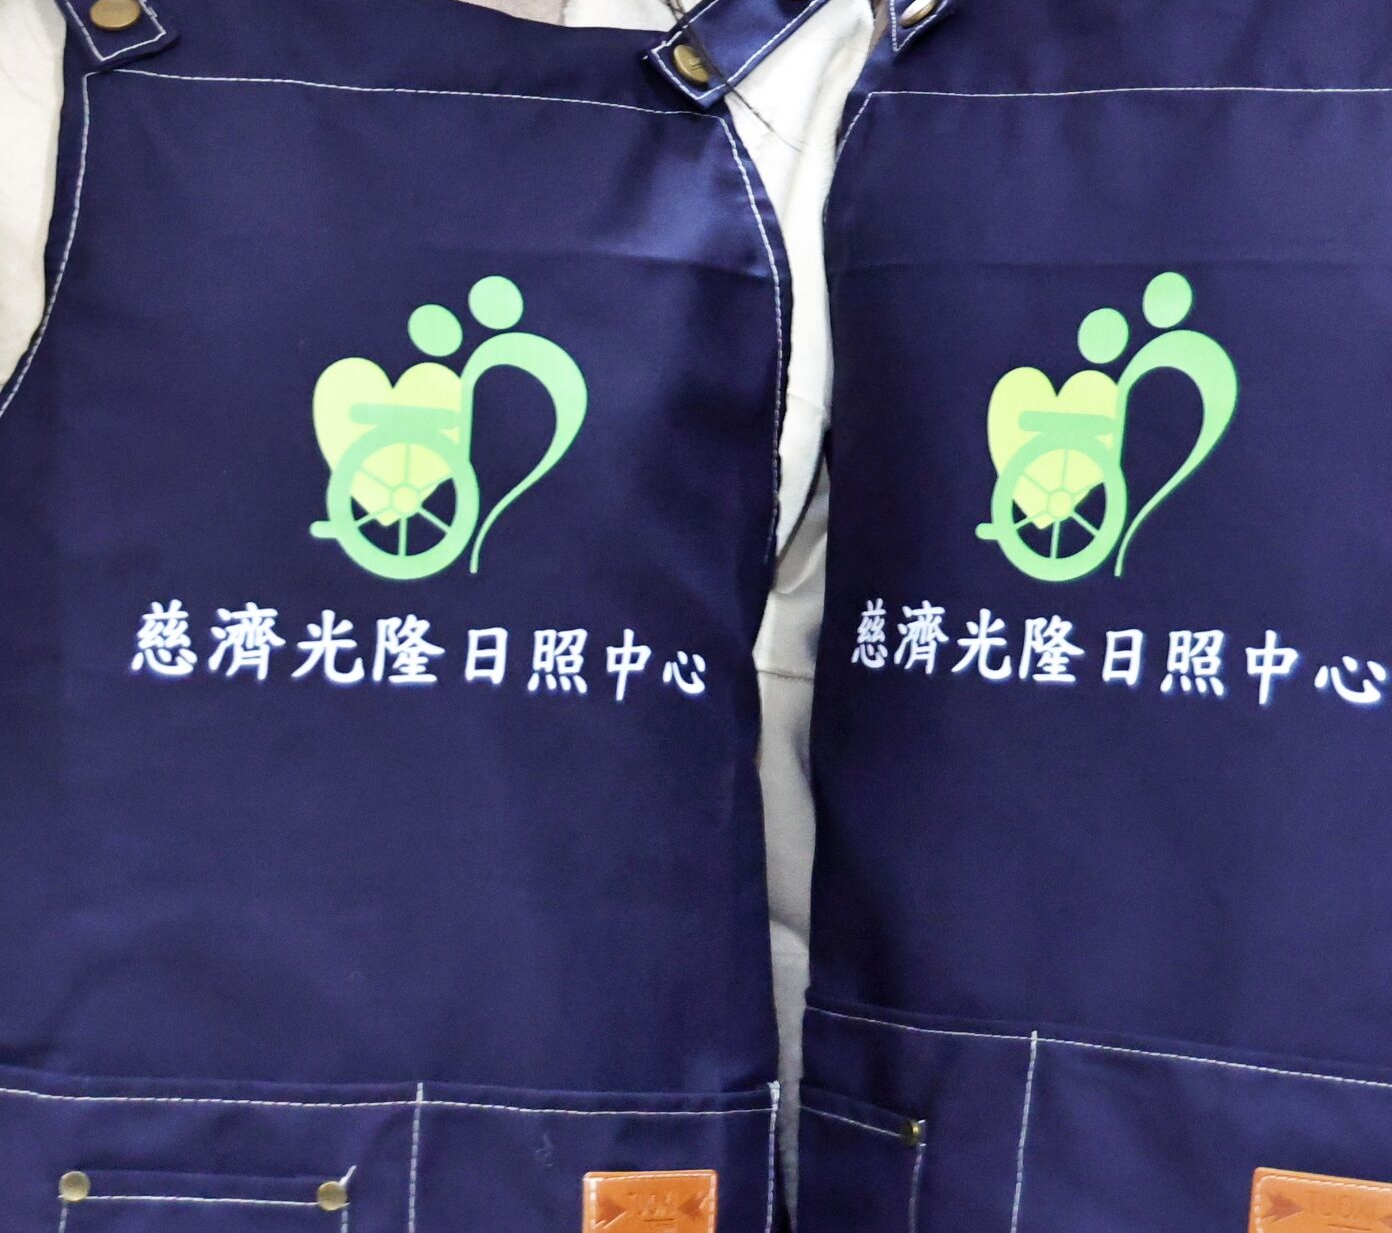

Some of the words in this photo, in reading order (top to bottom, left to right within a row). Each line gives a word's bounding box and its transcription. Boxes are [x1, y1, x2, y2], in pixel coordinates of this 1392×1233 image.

[130, 598, 706, 702] 慈濟光隆日照中心
[850, 597, 1388, 706] 慈濟光隆日照中心
